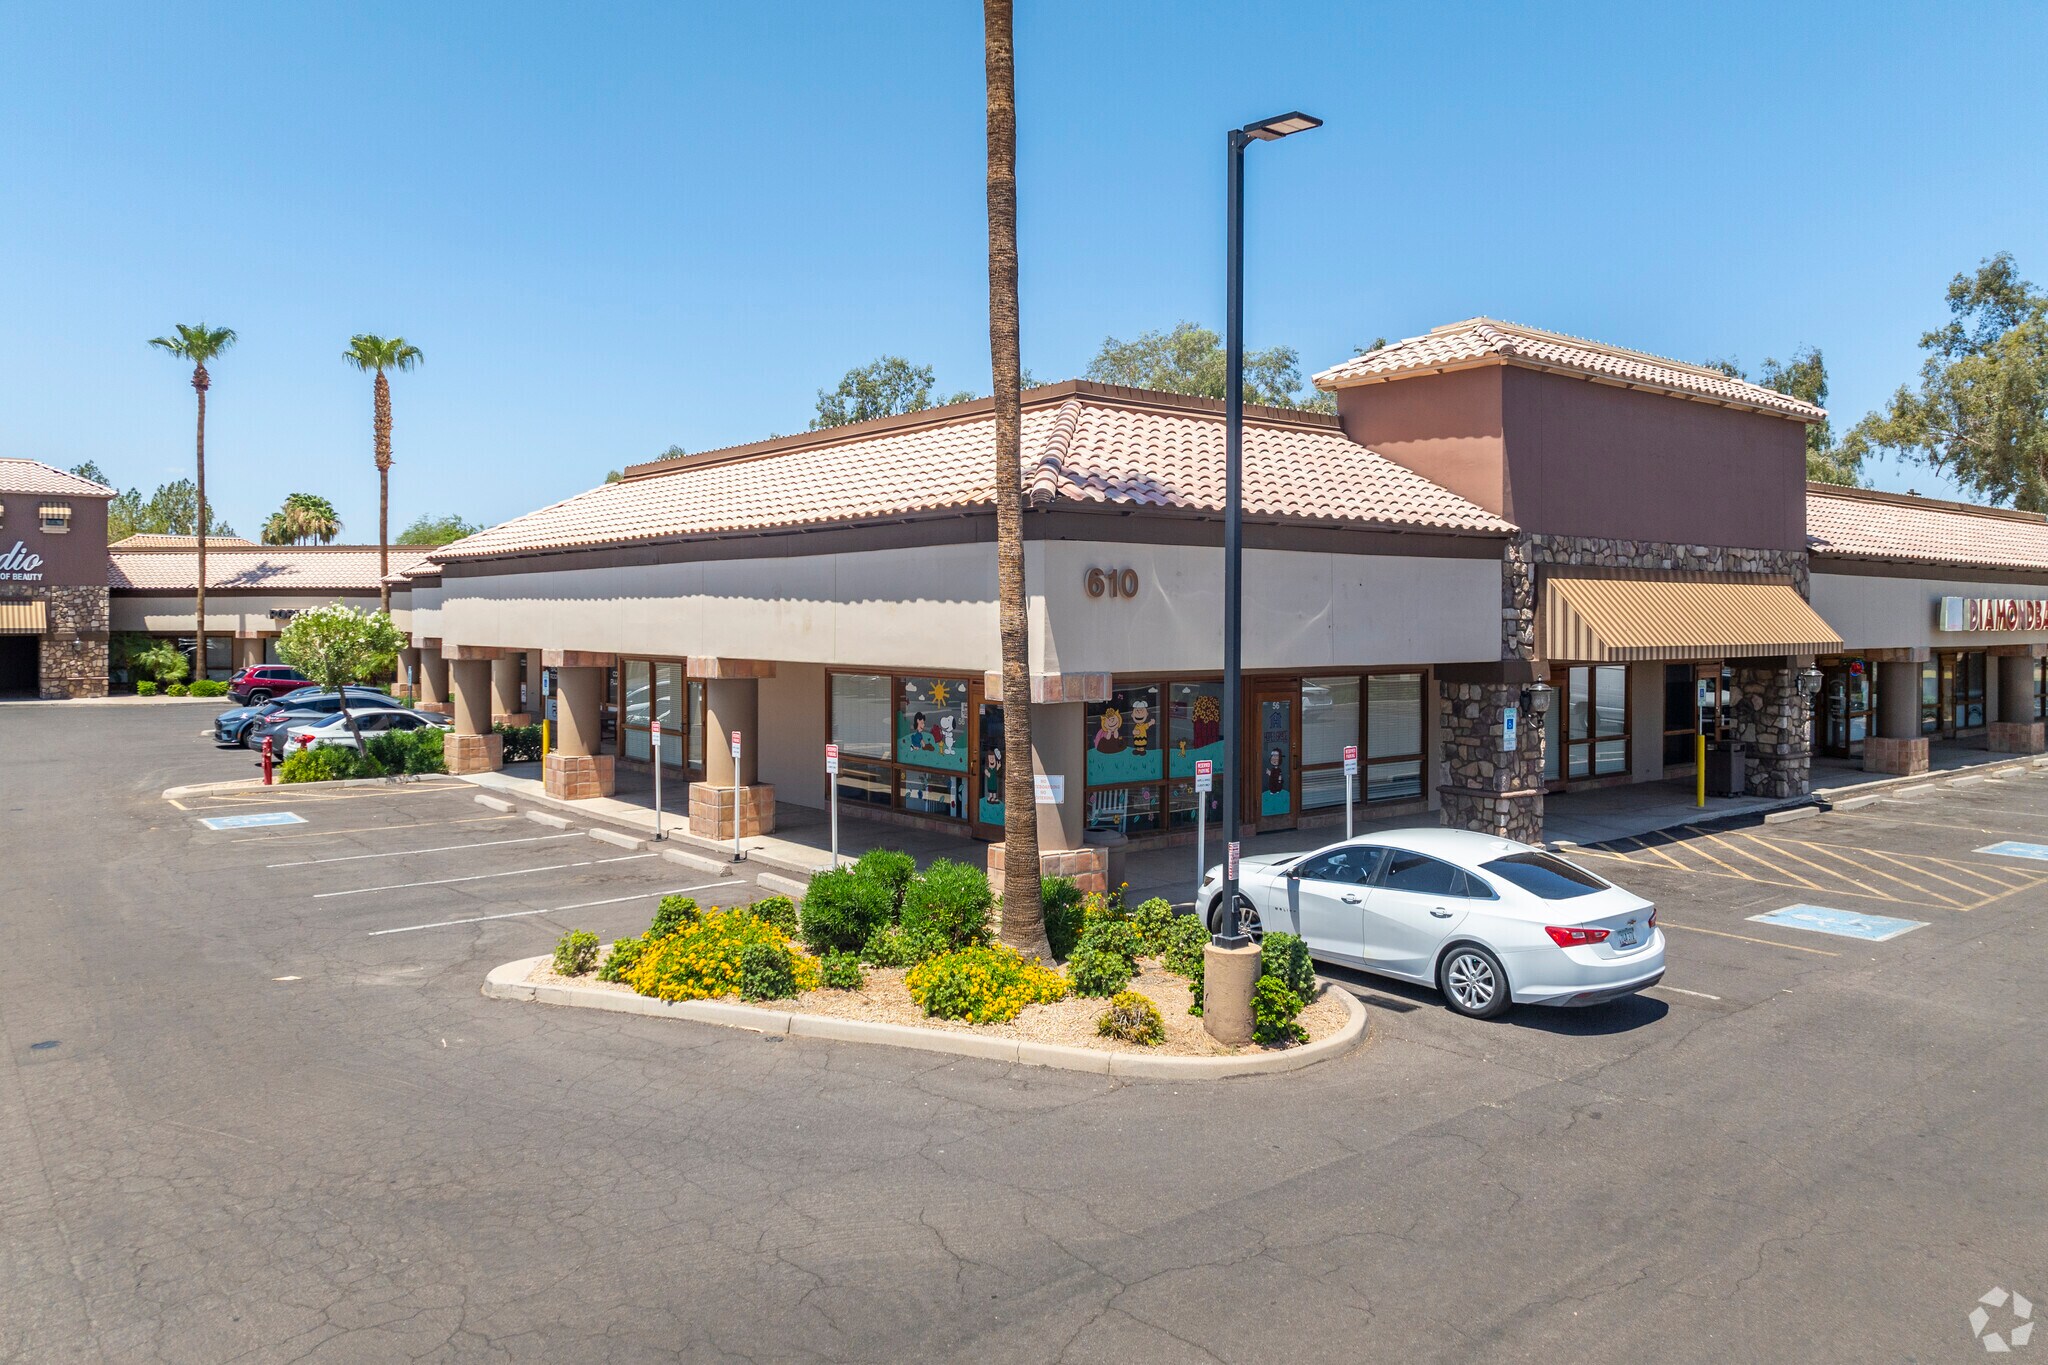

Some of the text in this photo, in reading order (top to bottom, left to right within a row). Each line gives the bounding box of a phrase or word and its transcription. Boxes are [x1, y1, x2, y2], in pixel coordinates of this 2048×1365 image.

[12, 573, 43, 581] BEAUTY
[1085, 567, 1139, 598] 610
[1272, 701, 1280, 710] 56
